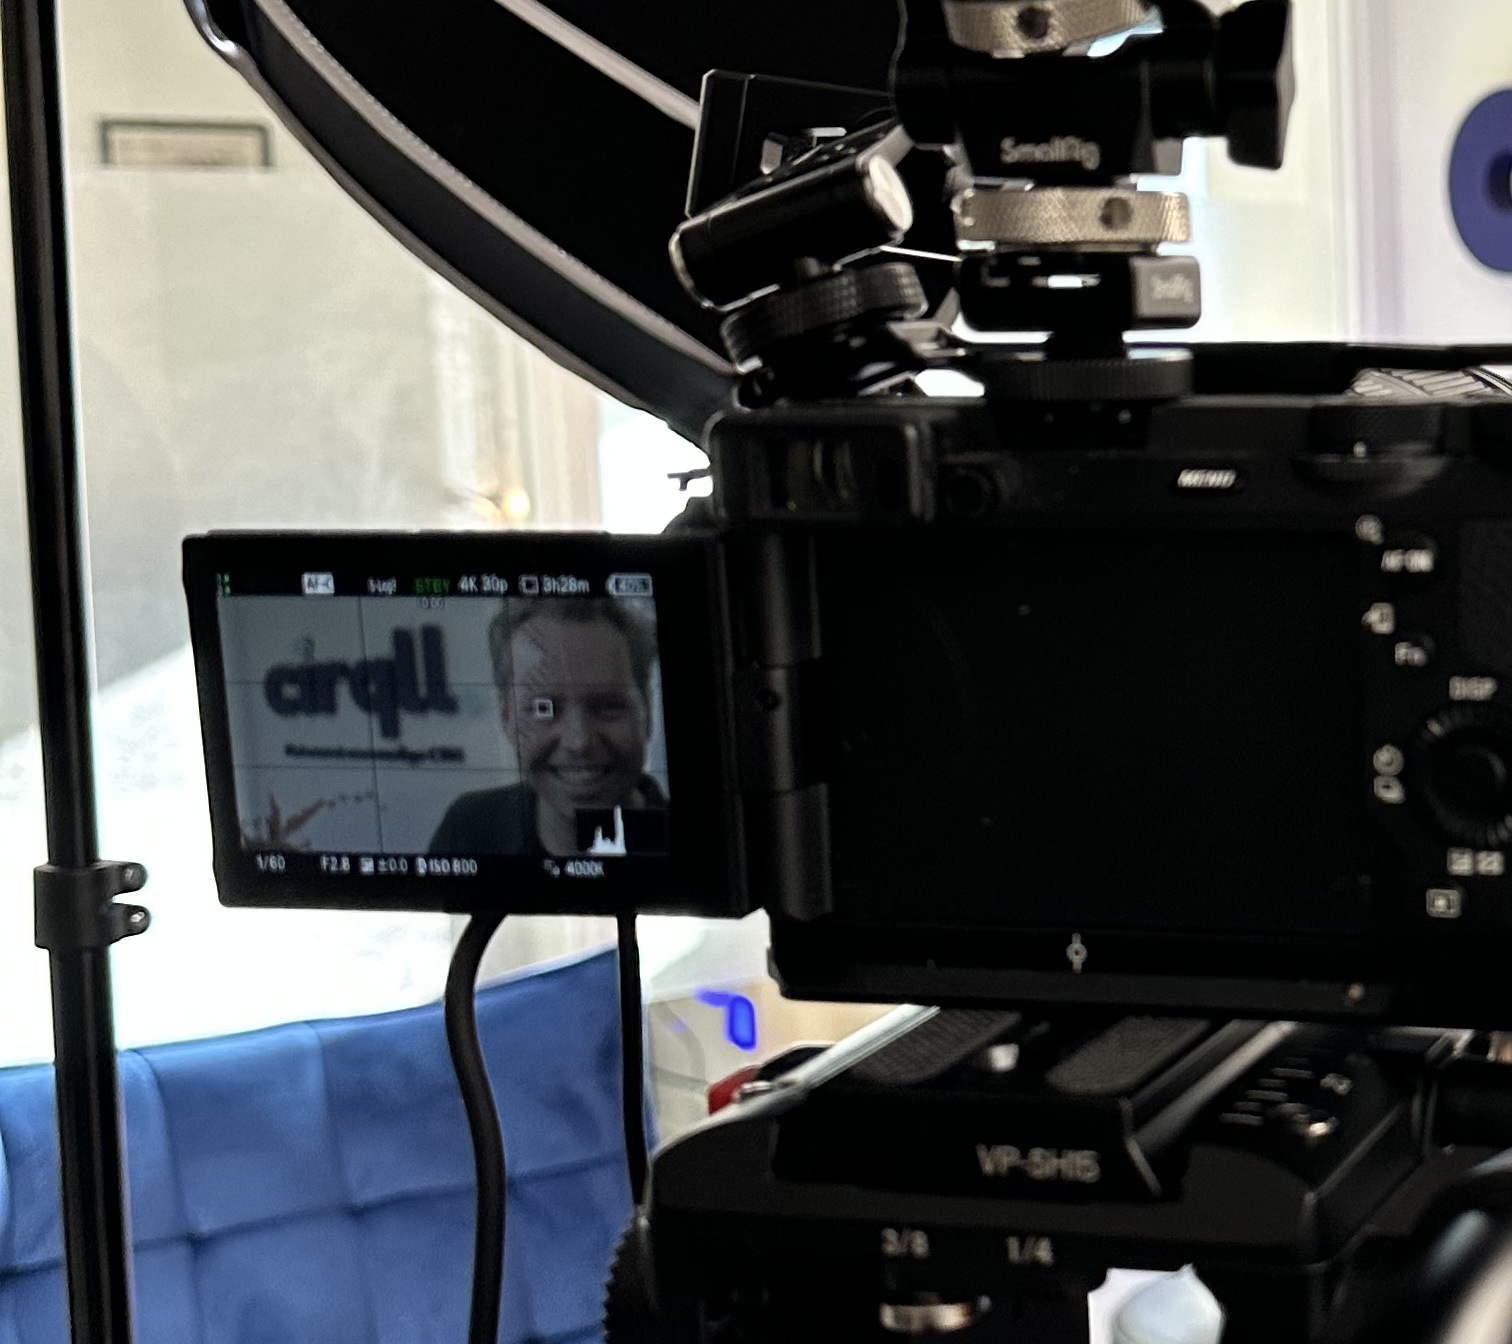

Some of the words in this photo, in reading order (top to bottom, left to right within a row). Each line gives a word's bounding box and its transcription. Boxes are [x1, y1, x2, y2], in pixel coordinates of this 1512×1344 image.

[457, 574, 479, 594] 4K
[541, 574, 590, 594] 3h28m
[256, 854, 286, 871] 1/60
[1006, 1235, 1053, 1266] 1/4
